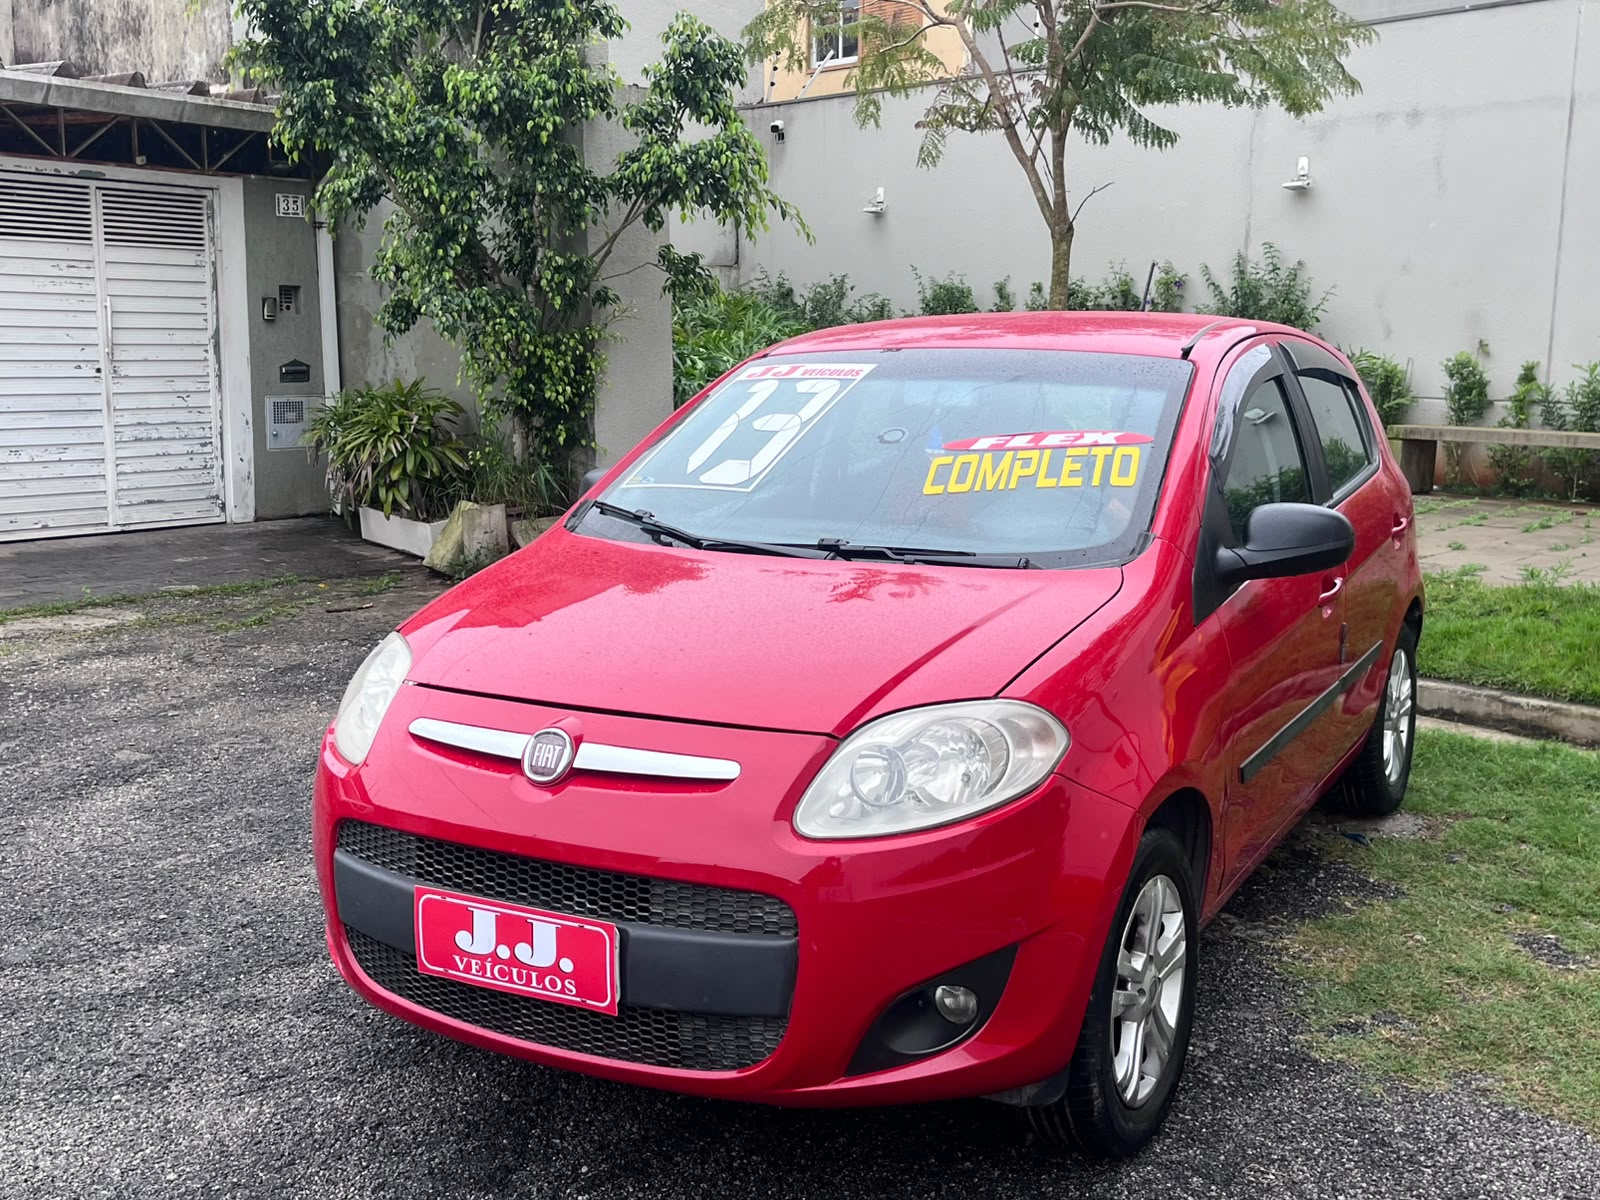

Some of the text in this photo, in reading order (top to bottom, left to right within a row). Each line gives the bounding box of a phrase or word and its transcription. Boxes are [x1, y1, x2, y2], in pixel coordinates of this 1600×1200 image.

[282, 198, 299, 212] 35
[687, 379, 841, 485] 13
[968, 432, 1125, 450] FLEX
[922, 446, 1141, 495] COMPLETO
[531, 743, 563, 769] FIAT
[454, 907, 574, 973] J.J.
[452, 954, 577, 996] VEÍCULOS
